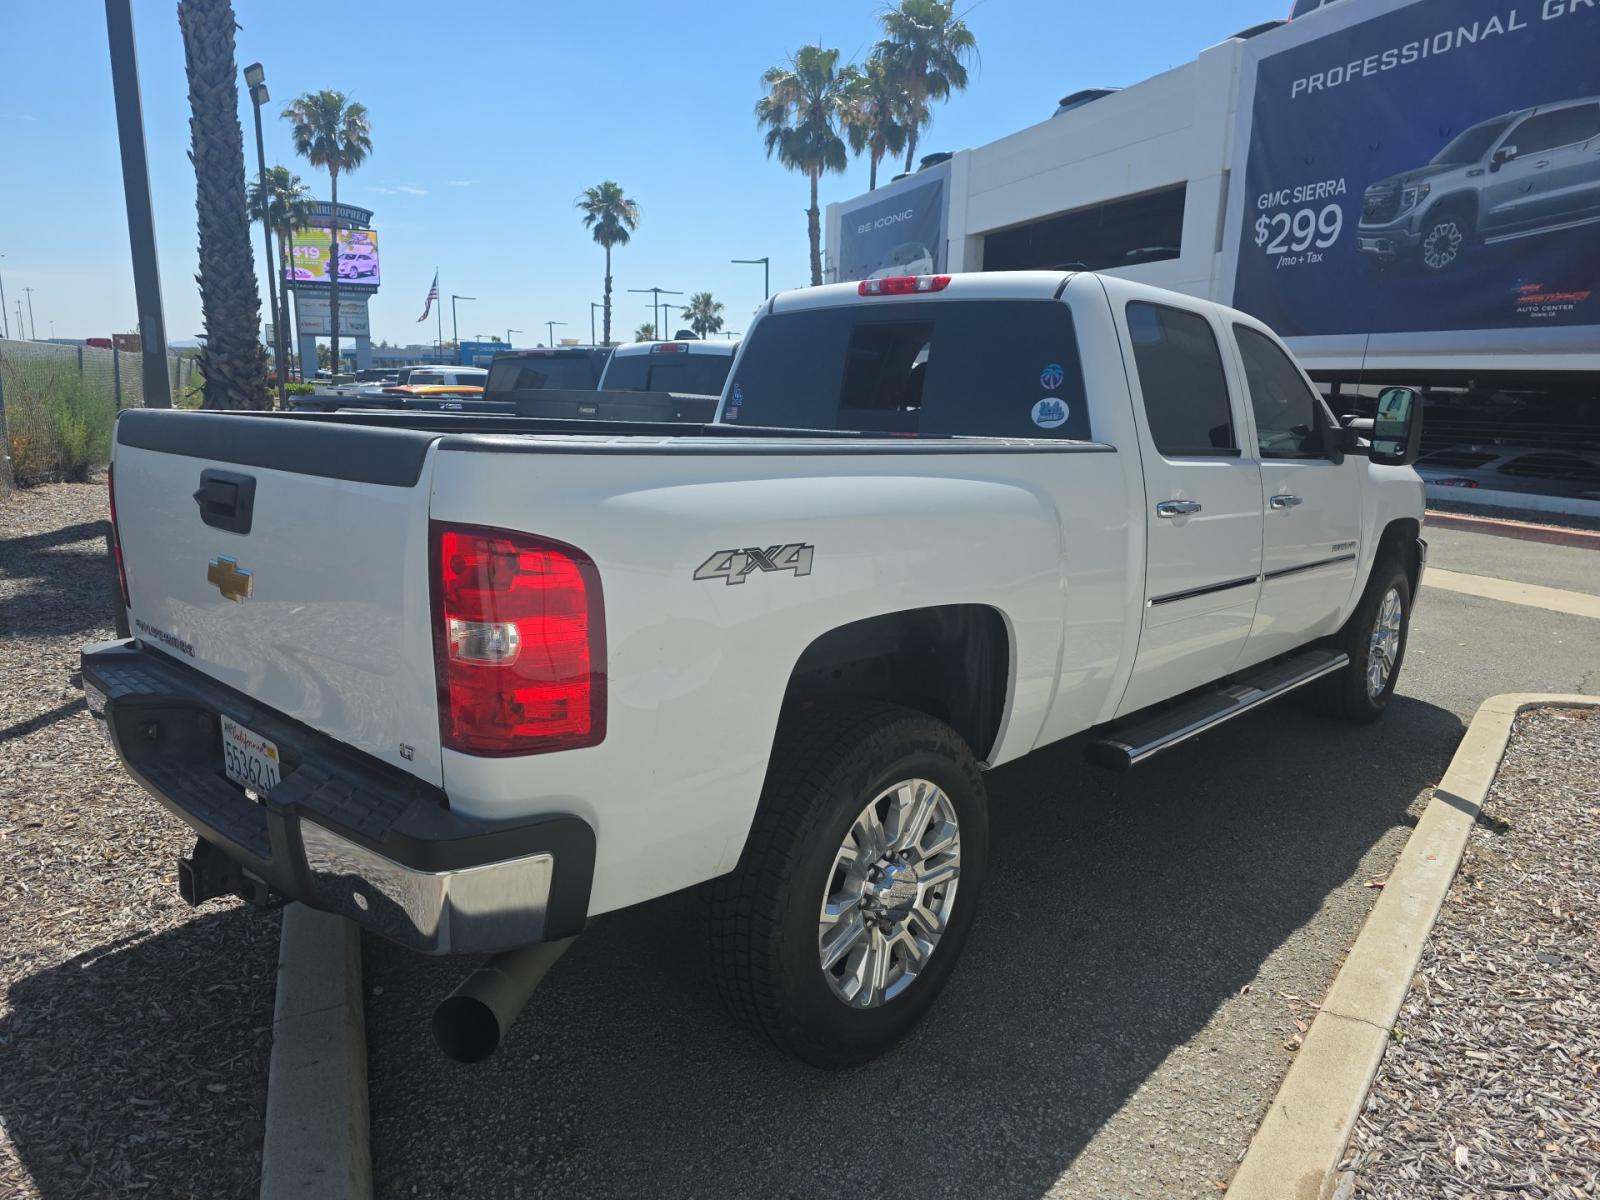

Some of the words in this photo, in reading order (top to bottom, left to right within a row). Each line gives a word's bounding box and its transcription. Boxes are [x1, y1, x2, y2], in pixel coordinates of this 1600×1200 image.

[1291, 9, 1528, 99] PROFESSIONAL
[1257, 189, 1291, 210] GMC
[1292, 177, 1347, 203] SIERRA
[311, 204, 369, 222] CHRITOPHER
[857, 223, 872, 234] BE
[874, 209, 913, 229] ICONIC
[1254, 203, 1343, 254] $299
[1276, 256, 1297, 270] /mo
[1307, 251, 1324, 264] Tax
[1516, 305, 1539, 313] AUTO
[1541, 304, 1574, 312] CENTER
